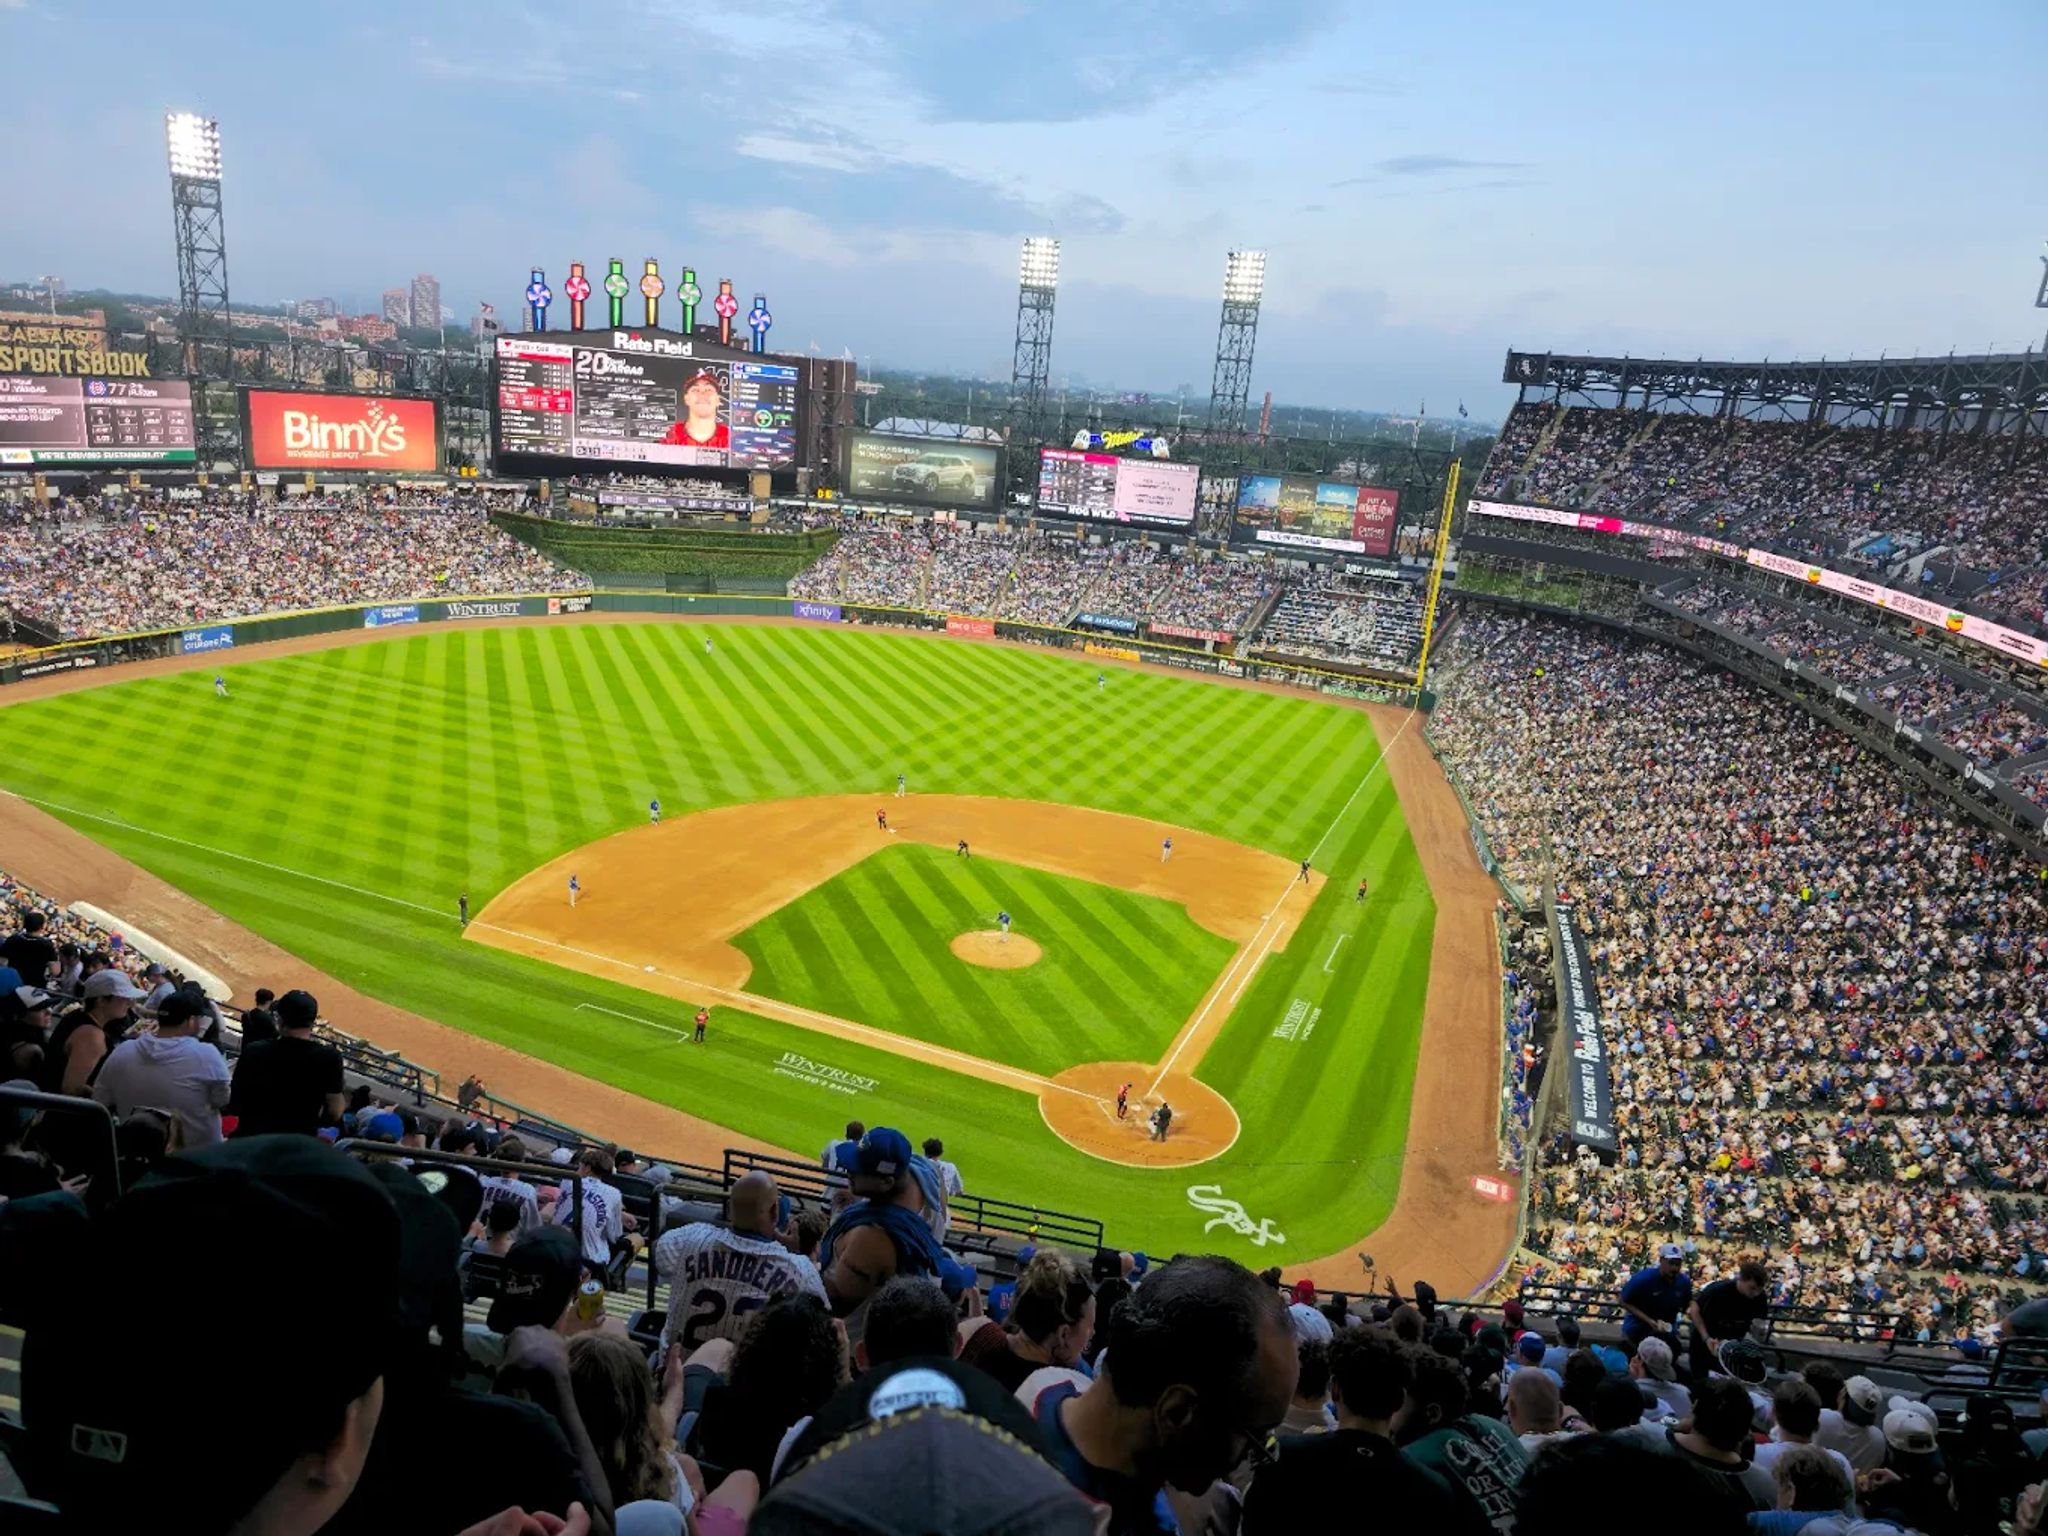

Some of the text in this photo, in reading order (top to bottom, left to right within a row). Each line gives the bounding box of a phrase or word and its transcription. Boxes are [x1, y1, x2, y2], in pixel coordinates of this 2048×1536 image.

[614, 331, 693, 356] Rate Field
[0, 345, 151, 377] SPORTSBOOK
[575, 351, 609, 375] 20
[108, 383, 127, 396] 77
[283, 410, 408, 457] Binny's
[1101, 430, 1145, 449] Miller
[287, 450, 360, 459] BEVERAGE DEPOT
[447, 602, 521, 616] WINTRUST
[799, 605, 833, 619] xfinity
[1574, 1010, 1598, 1037] Field
[781, 1052, 880, 1087] WINTRUST
[1581, 1063, 1595, 1075] TO
[1582, 1075, 1598, 1119] WELCOME
[685, 1251, 801, 1296] SANDBER
